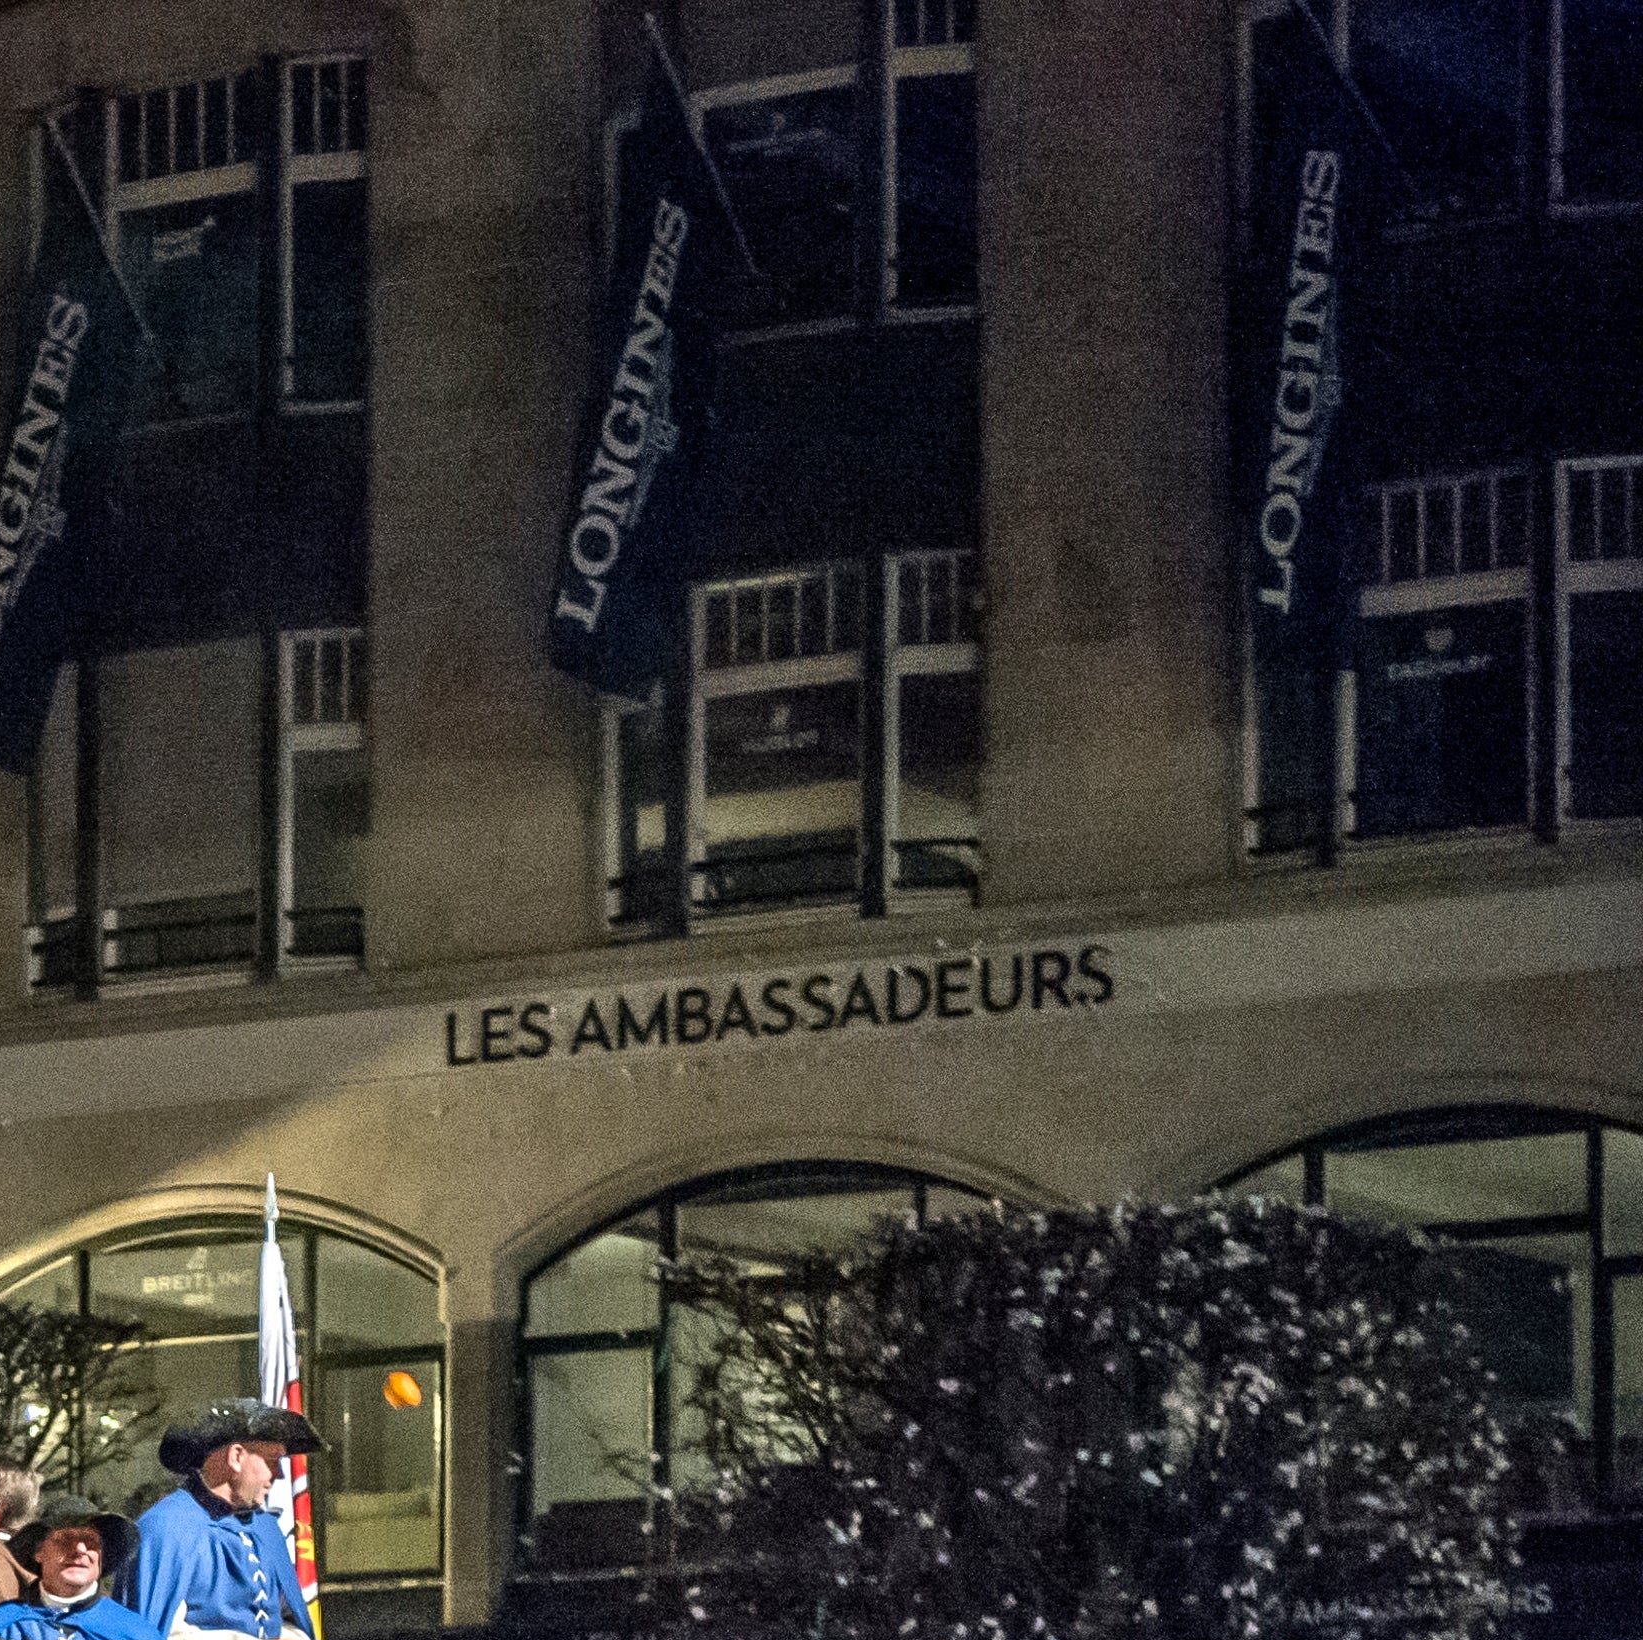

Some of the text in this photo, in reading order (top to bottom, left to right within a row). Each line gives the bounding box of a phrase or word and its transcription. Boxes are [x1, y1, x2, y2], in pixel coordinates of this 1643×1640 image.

[554, 196, 691, 634] LONGINES
[1257, 148, 1340, 615] LONGINES
[446, 944, 1115, 1067] LES AMBASSADEURS
